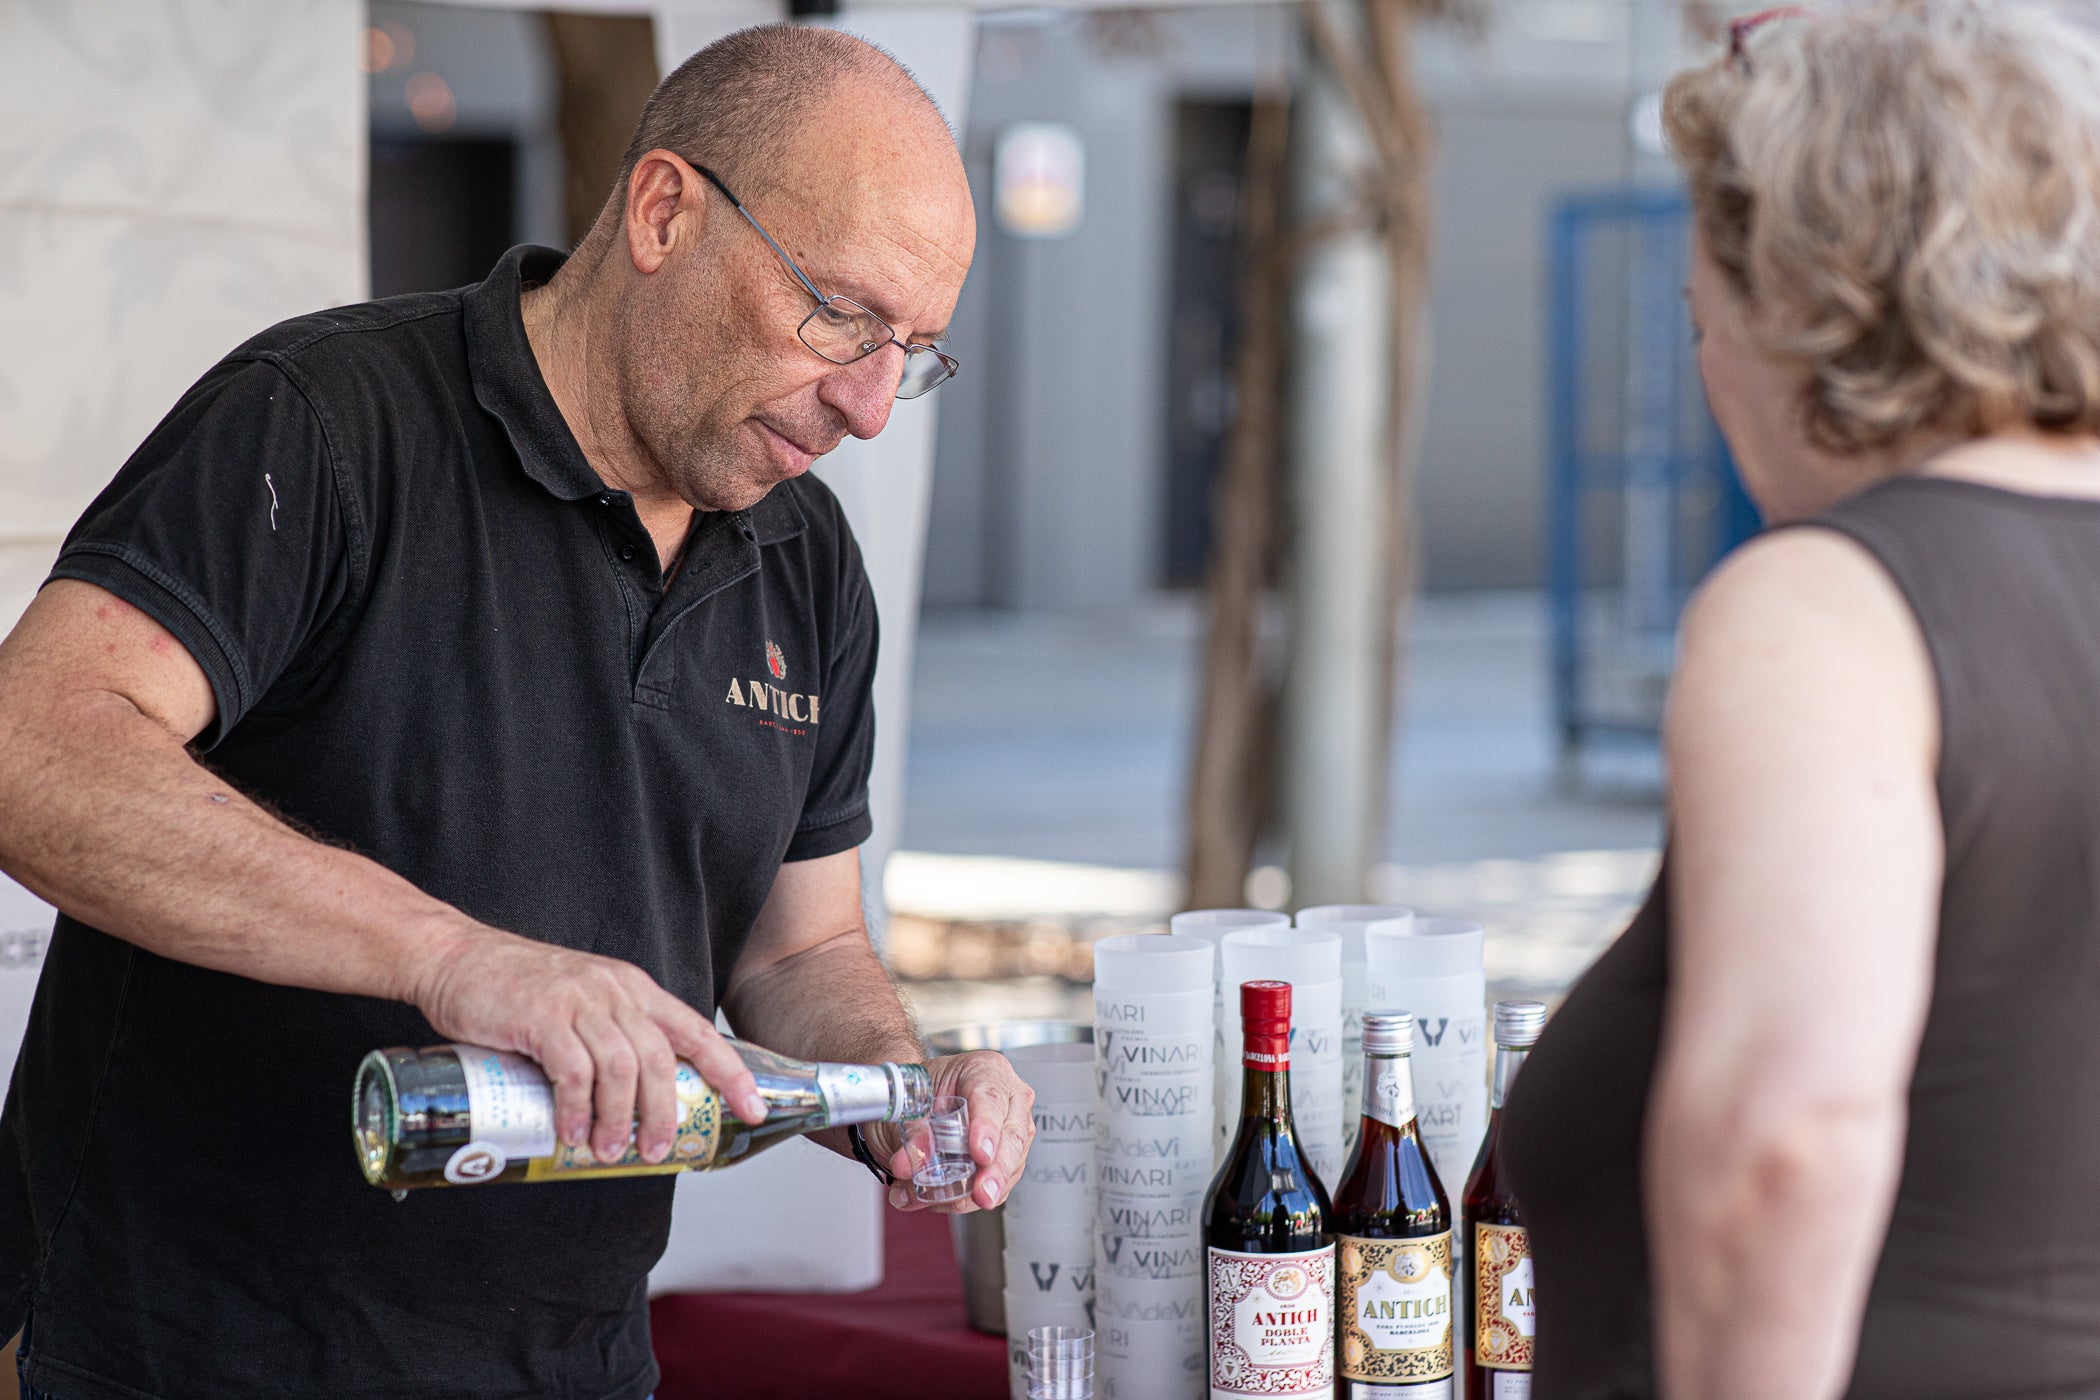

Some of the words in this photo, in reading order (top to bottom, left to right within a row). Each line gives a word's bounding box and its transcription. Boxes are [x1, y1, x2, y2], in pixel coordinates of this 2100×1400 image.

[1362, 1293, 1448, 1320] ANTICH
[1251, 1307, 1318, 1327] ANTICH
[1265, 1326, 1309, 1338] DOBLE
[1260, 1336, 1311, 1347] PLANTA
